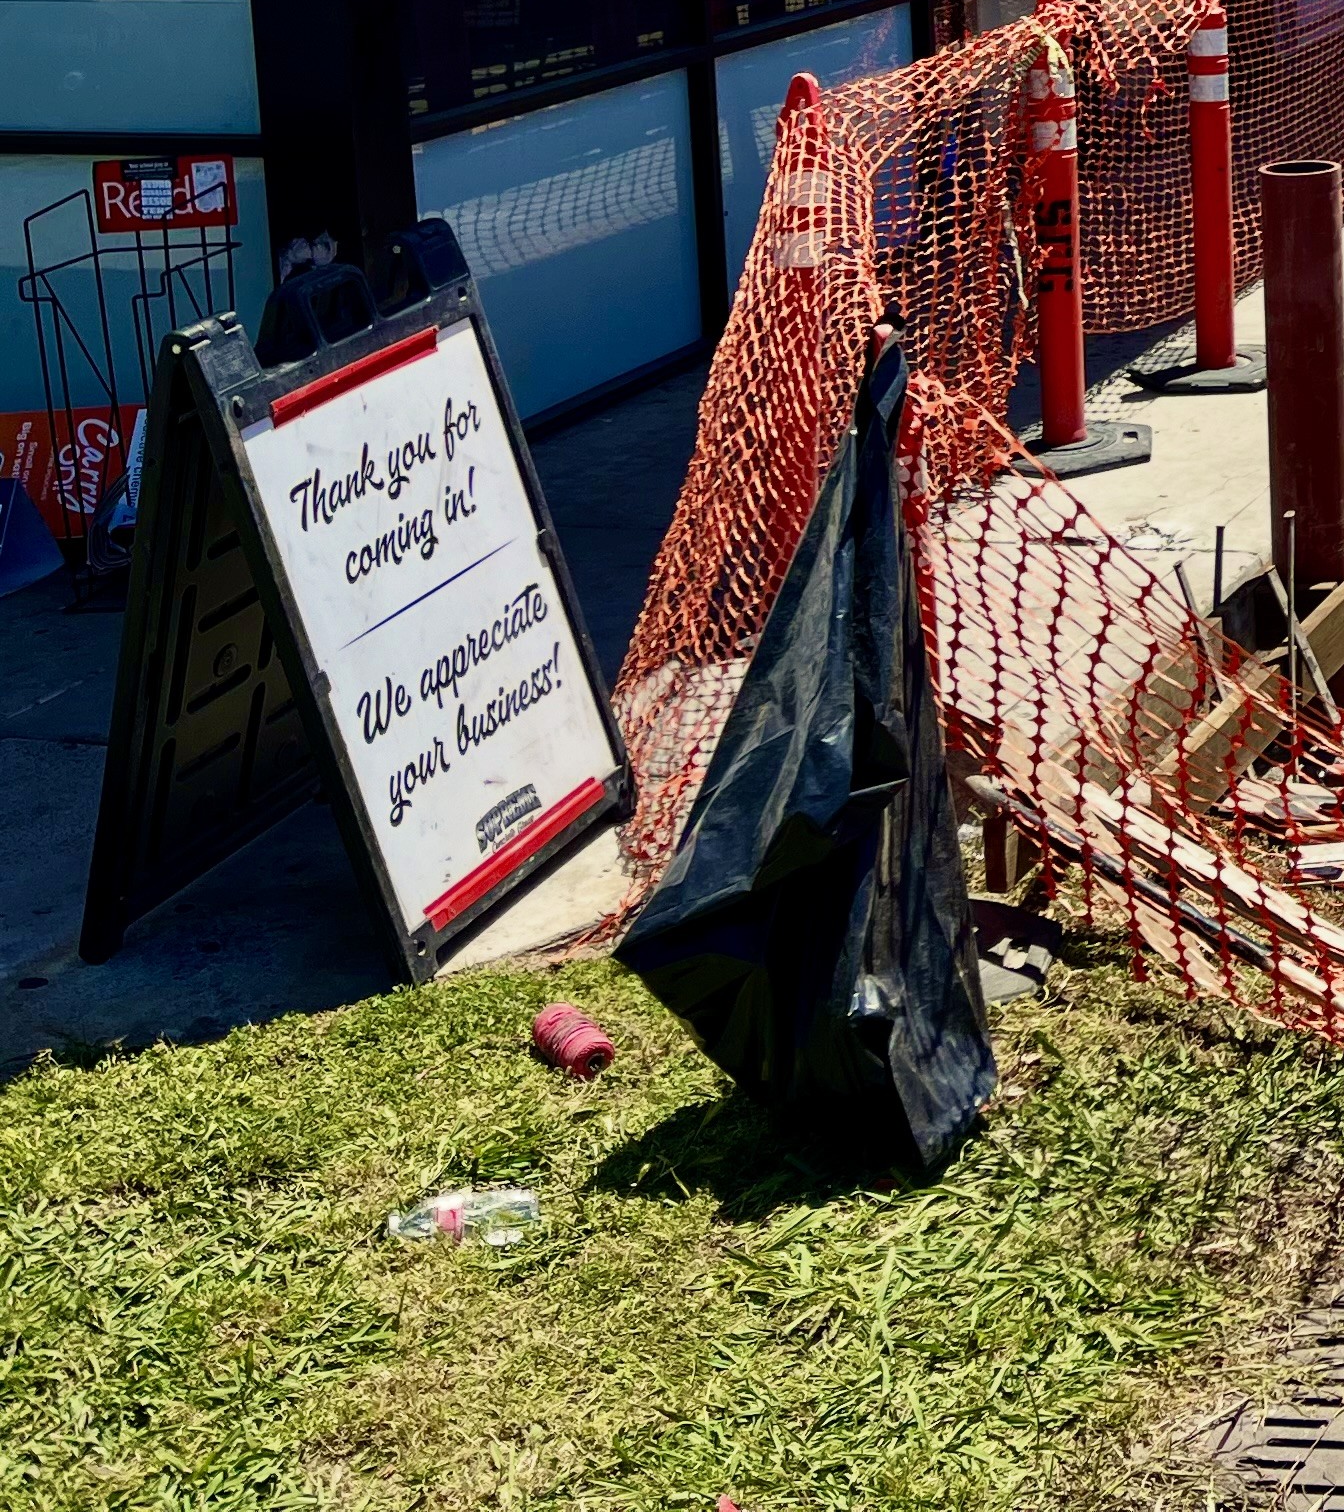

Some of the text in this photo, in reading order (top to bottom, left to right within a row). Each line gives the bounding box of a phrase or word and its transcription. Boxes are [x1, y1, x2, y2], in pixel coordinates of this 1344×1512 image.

[289, 397, 481, 532] Thank you for
[345, 466, 477, 584] coming in!
[356, 582, 548, 744] We appreciate
[389, 641, 563, 827] your business!
